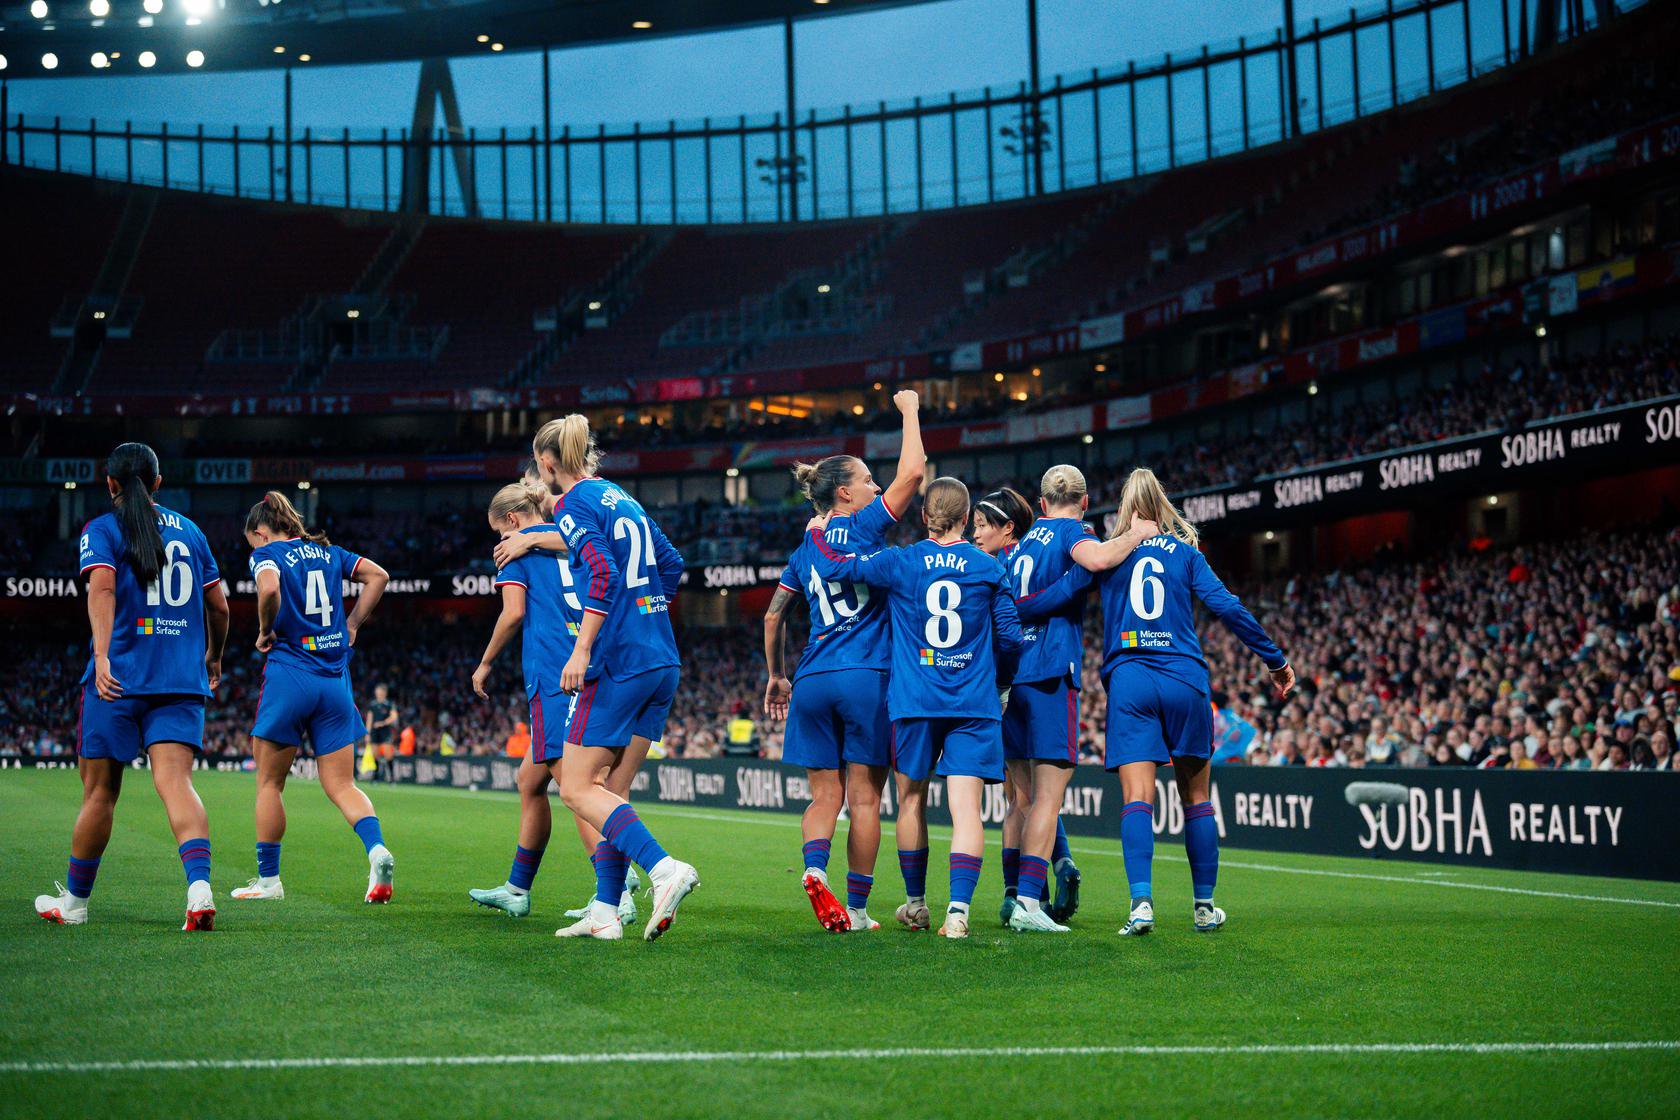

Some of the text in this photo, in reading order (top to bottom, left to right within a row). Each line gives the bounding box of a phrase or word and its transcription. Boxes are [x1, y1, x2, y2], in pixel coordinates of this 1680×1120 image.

[1501, 422, 1621, 469] SOBHA REALTY
[51, 461, 91, 479] AND
[200, 462, 246, 480] OVER
[1379, 448, 1482, 491] SOBHA REALTY
[1183, 494, 1227, 523] SOBHA
[1274, 471, 1364, 509] SOBHA REALTY
[924, 552, 968, 572] PARK
[6, 576, 78, 598] SOBHA
[305, 569, 334, 627] 4
[452, 574, 497, 596] SOB
[1130, 556, 1165, 620] 6
[925, 580, 962, 649] 8
[318, 641, 341, 650] Surface
[1140, 639, 1170, 647] Surface
[936, 657, 965, 669] Surface
[657, 764, 695, 801] SOBHA
[736, 766, 784, 808] SOBHA
[1236, 792, 1314, 830] REALTY
[1358, 786, 1624, 857] SOBHA REALTY
